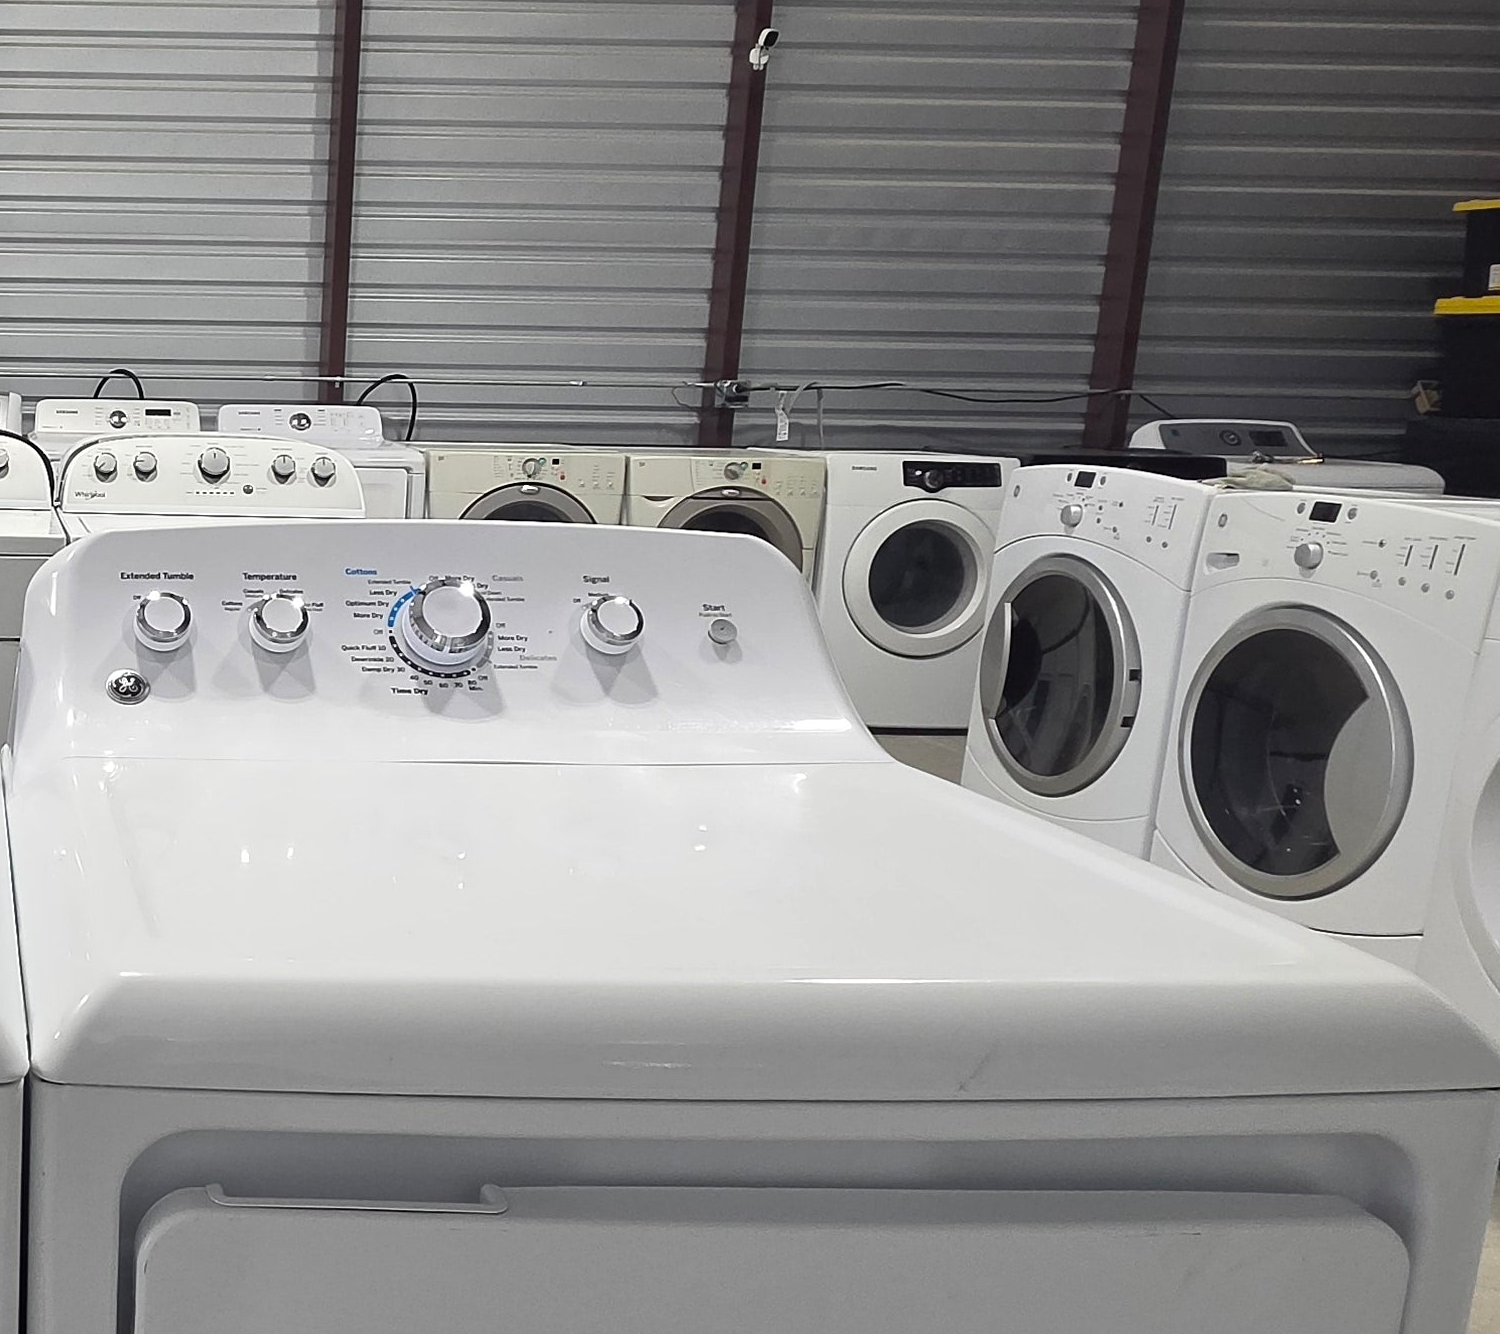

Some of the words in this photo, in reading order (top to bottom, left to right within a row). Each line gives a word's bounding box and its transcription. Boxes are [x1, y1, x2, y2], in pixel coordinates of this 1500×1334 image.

[74, 491, 106, 500] Whirlpool
[120, 571, 161, 579] Extended
[162, 571, 194, 579] Tumble
[242, 572, 297, 581] Temperature
[491, 574, 524, 582] Casuals
[582, 575, 610, 584] Signal
[476, 582, 489, 590] Dry
[377, 600, 390, 608] Dry
[702, 603, 725, 612] Start
[413, 687, 429, 696] Dry
